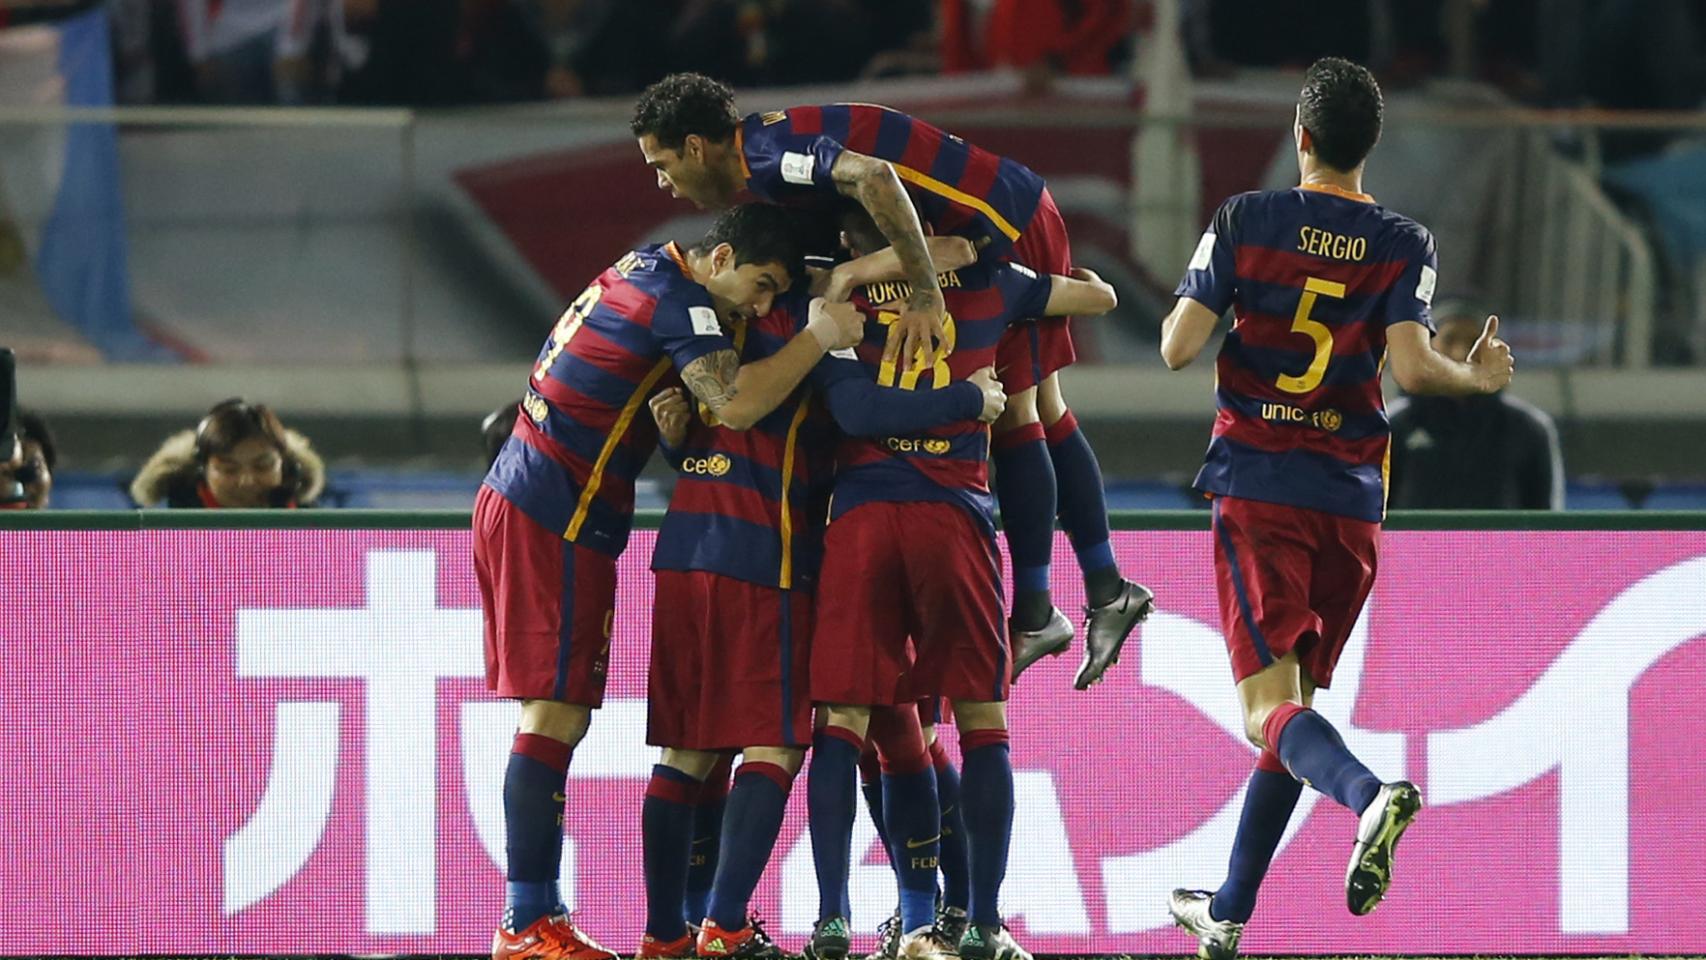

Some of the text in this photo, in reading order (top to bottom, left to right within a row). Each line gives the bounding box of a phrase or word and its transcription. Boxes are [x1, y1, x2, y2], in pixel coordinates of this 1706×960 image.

[1297, 225, 1366, 262] SERGIO
[1274, 276, 1346, 394] 5
[1261, 403, 1320, 428] unicf
